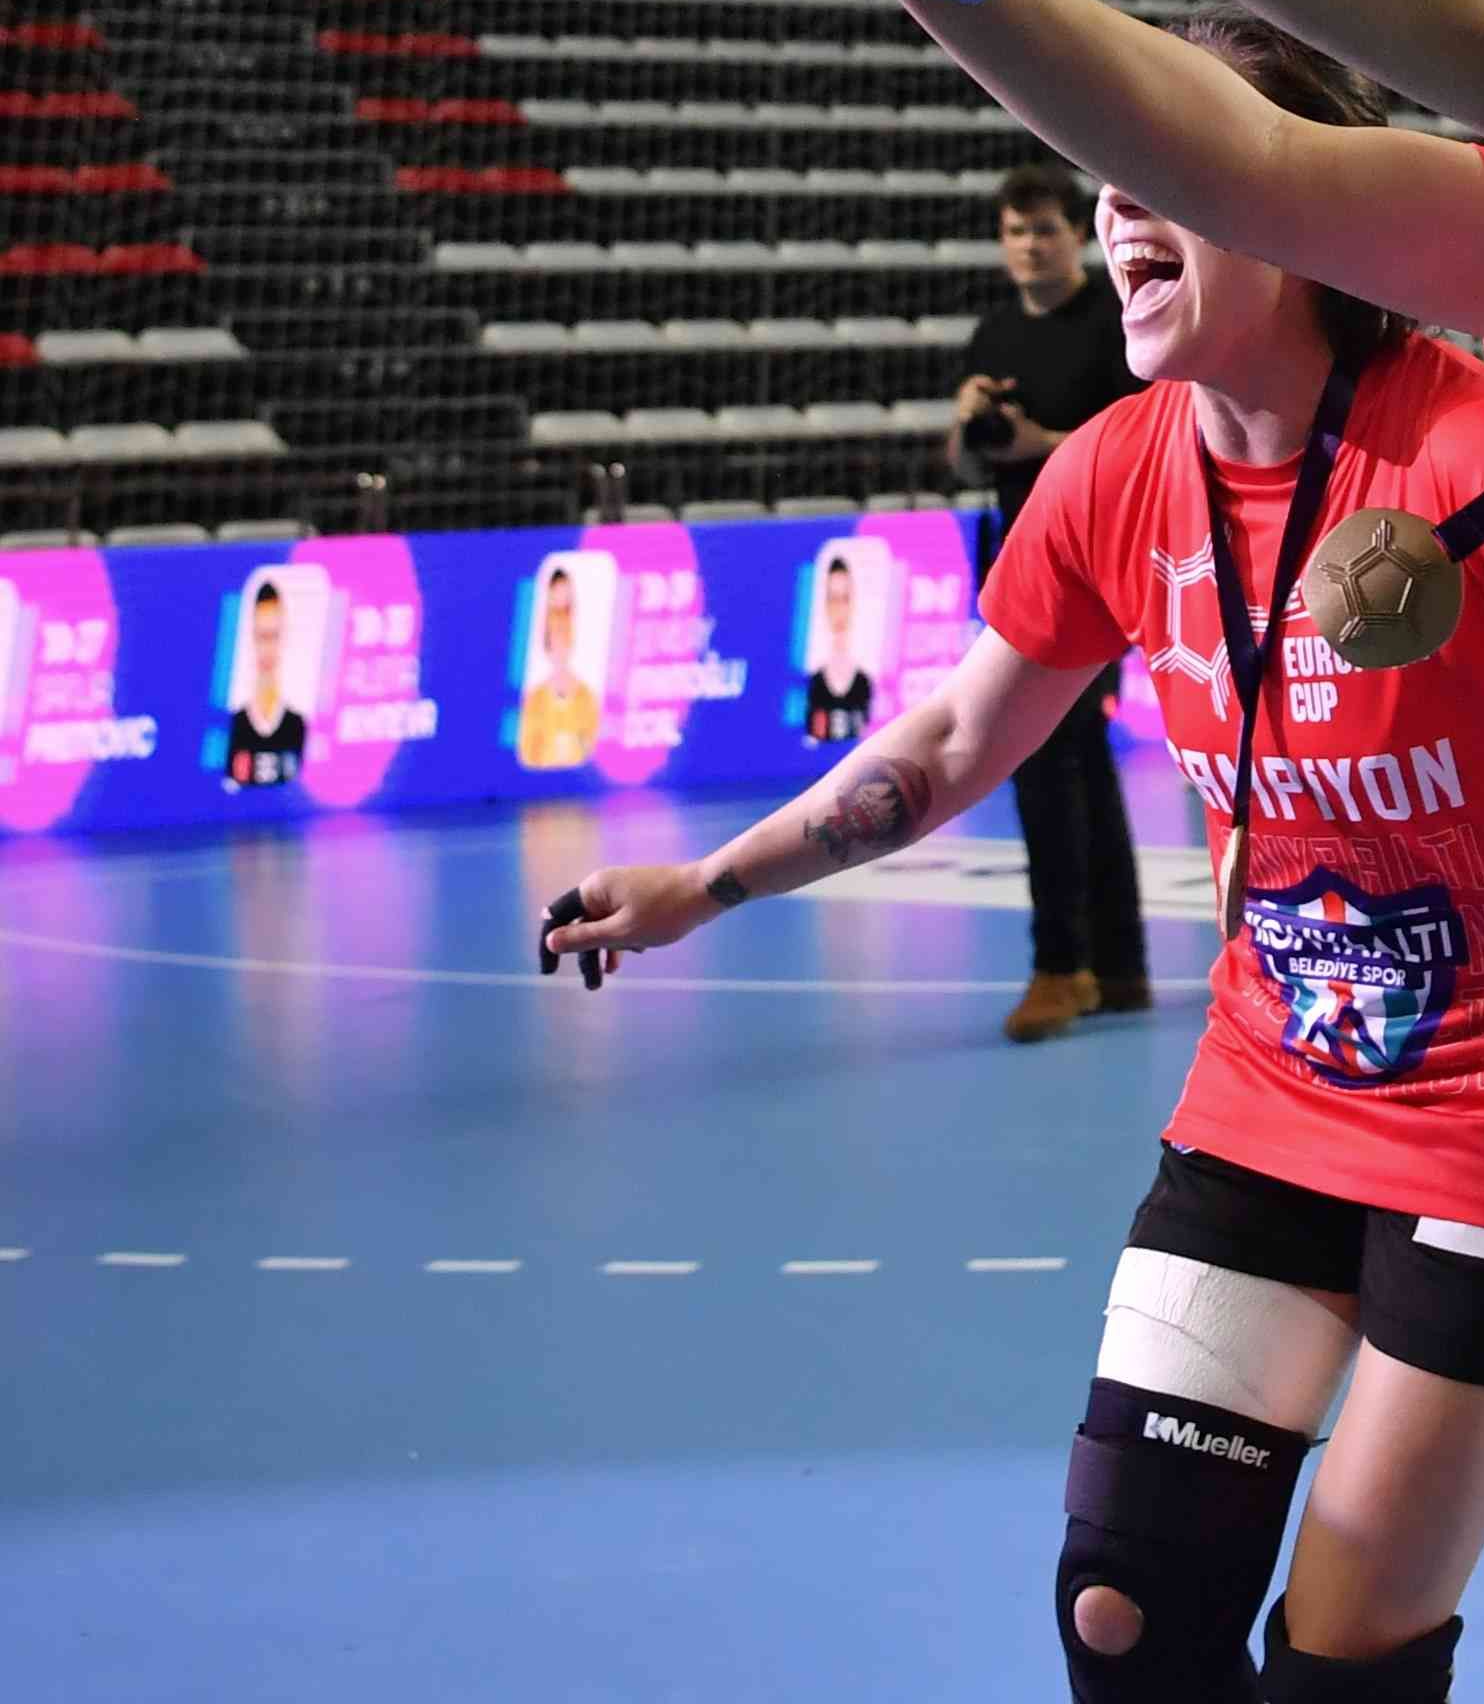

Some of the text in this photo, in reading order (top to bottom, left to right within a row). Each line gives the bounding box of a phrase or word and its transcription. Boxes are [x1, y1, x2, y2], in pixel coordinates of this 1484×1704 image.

[1288, 681, 1339, 723] CUP
[1166, 737, 1465, 823] AMPIYON
[1361, 964, 1407, 987] SPOR
[1158, 1415, 1272, 1468] Mueller
